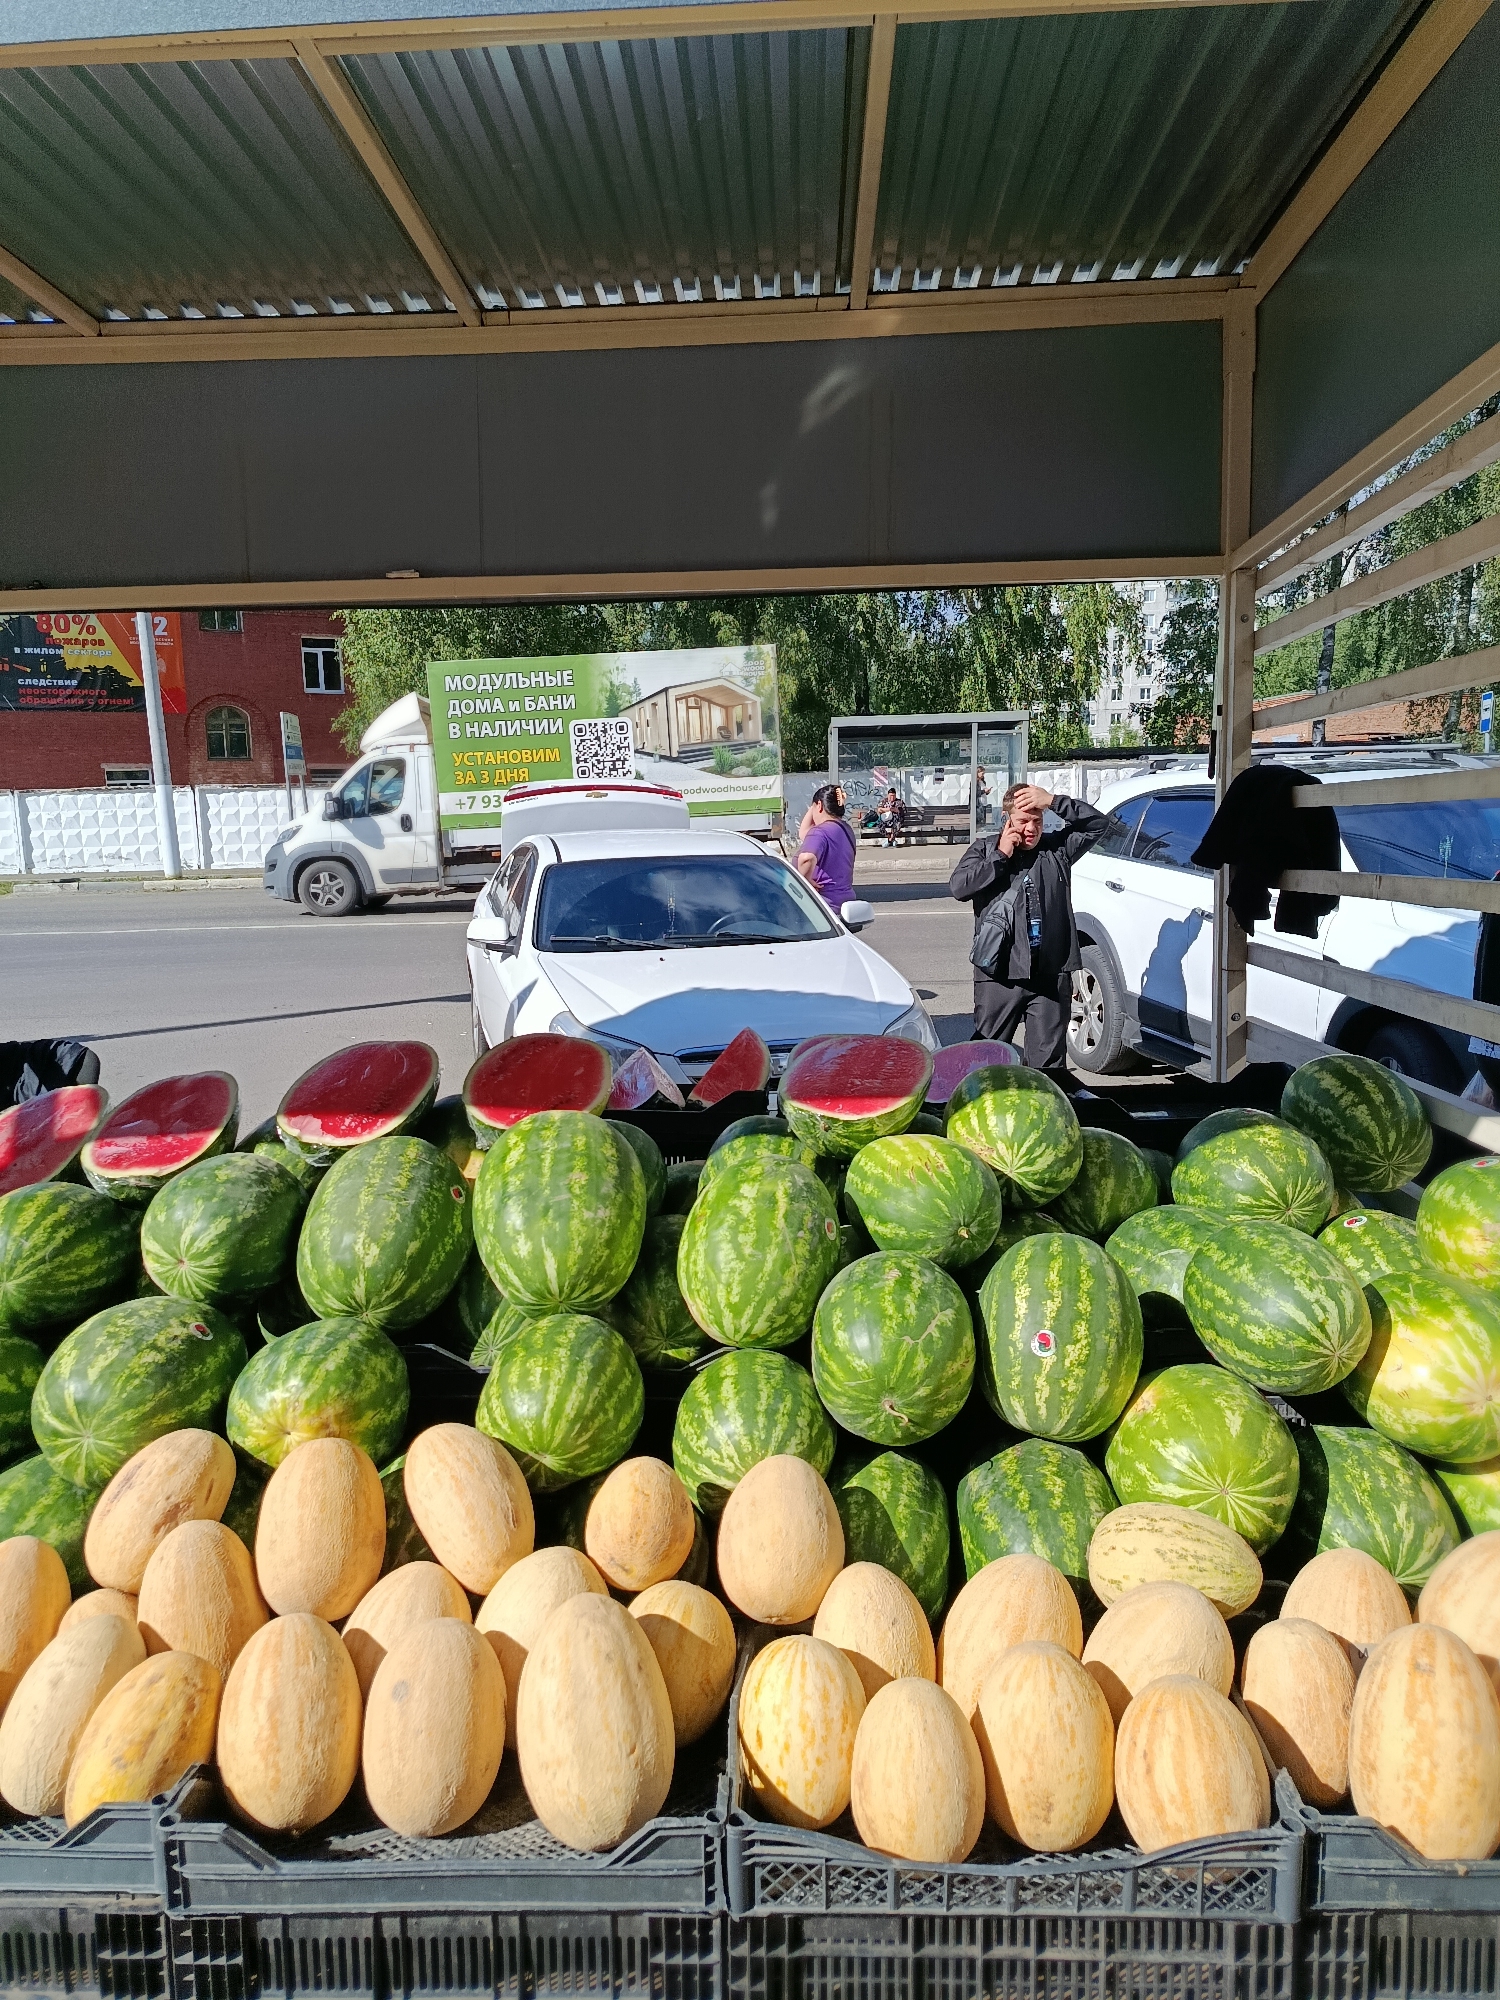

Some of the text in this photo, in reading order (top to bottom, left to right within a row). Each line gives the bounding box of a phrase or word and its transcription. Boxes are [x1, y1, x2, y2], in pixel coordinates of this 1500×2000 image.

[36, 613, 96, 636] 80%
[45, 637, 105, 648] пожаров
[24, 647, 64, 655] жилом
[67, 648, 112, 657] секторе
[18, 678, 78, 687] следствие
[444, 669, 575, 694] МОДУЛЬНЫЕ
[19, 687, 107, 696] неосторожного
[19, 696, 85, 705] обращения
[97, 697, 135, 706] огнем!
[447, 694, 577, 719] ДОМА и БАНИ
[448, 717, 564, 739] В НАЛИЧИИ
[452, 747, 561, 767] УСТАНОВИМ
[454, 767, 530, 786] ЗА 3 ДНЯ
[455, 795, 477, 810] +7
